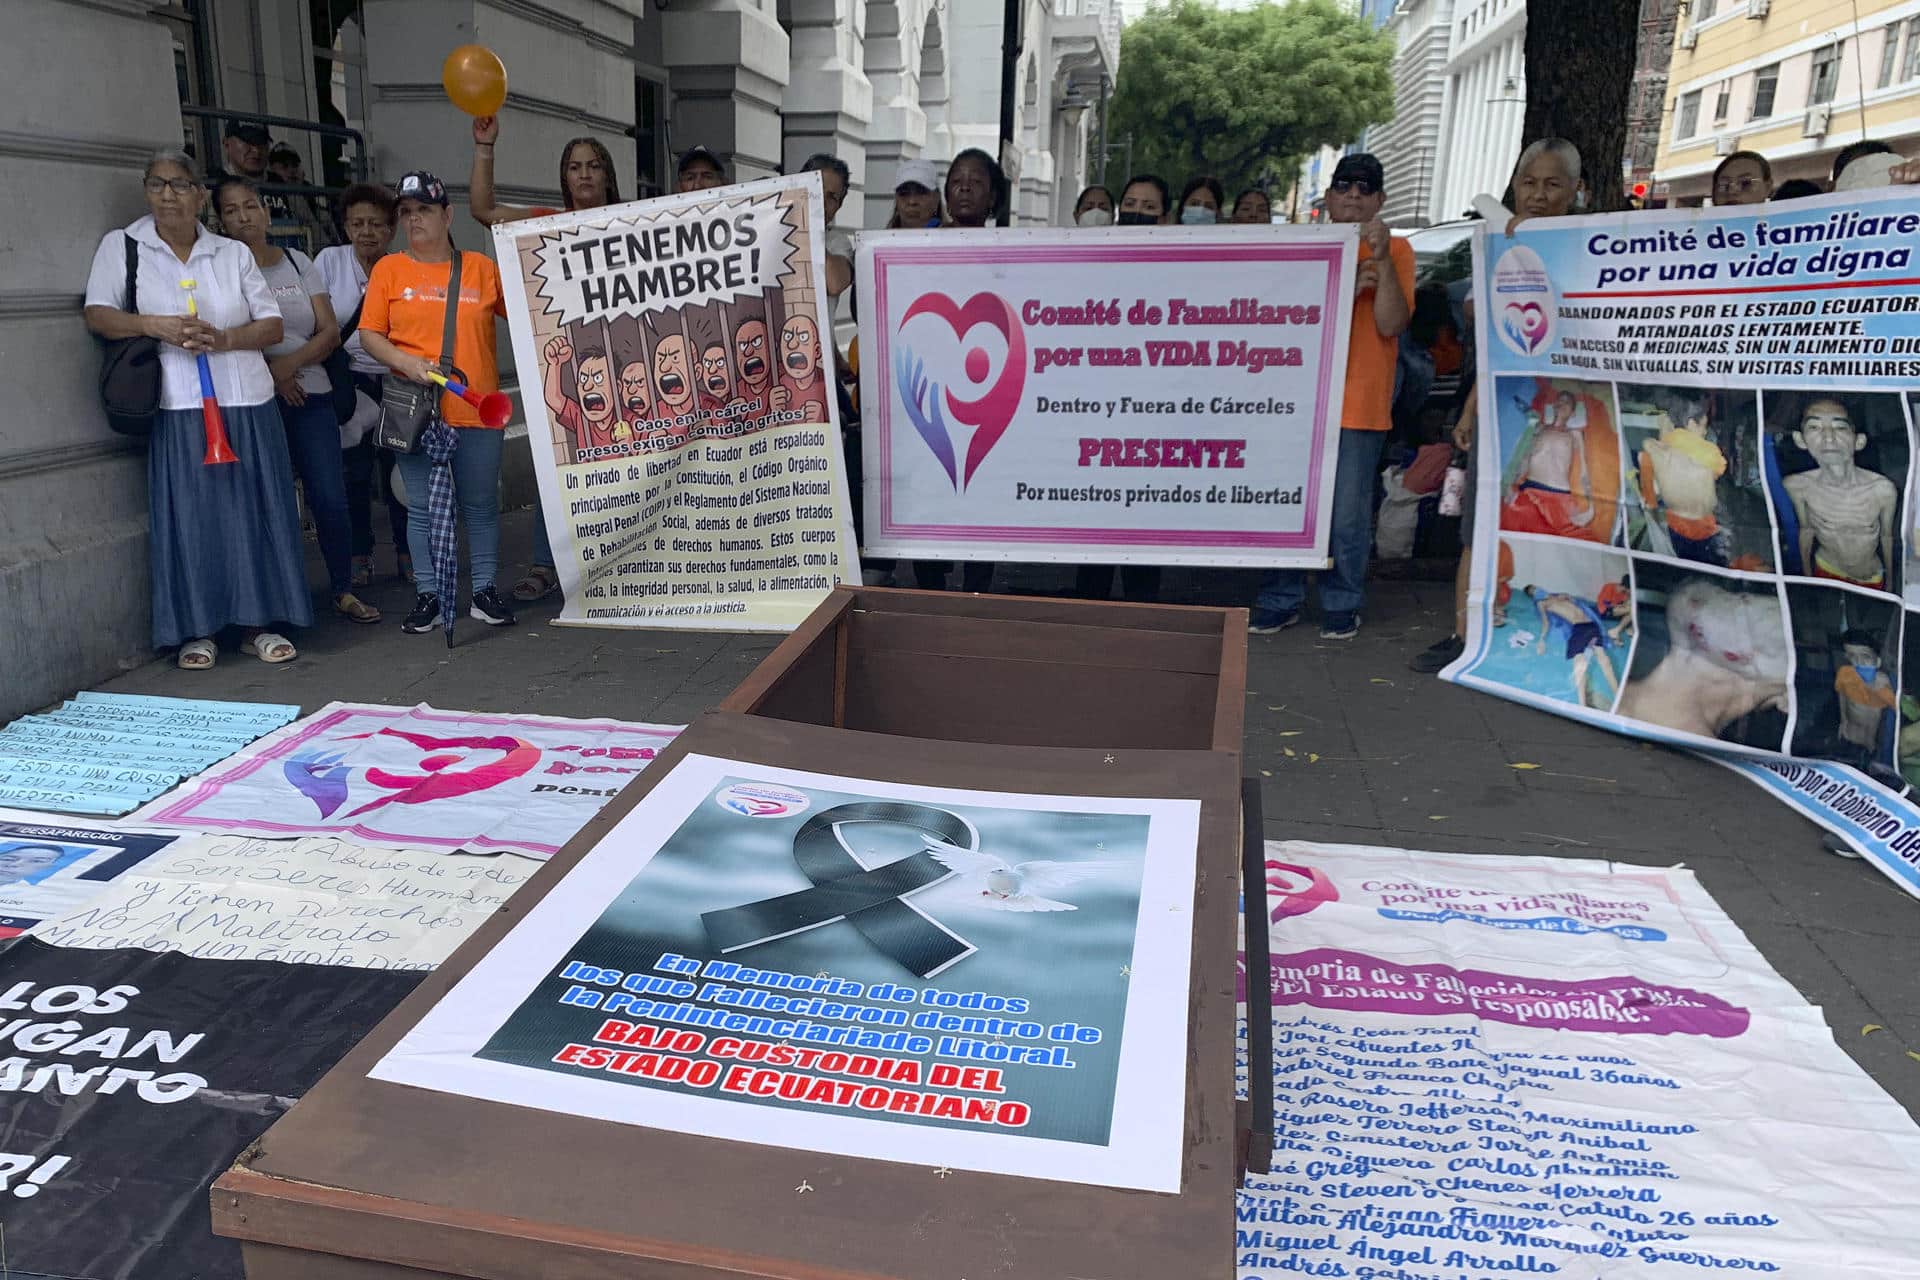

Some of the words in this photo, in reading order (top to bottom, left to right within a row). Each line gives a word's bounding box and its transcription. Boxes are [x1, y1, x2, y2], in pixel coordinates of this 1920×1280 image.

[559, 213, 758, 280] ¡TENEMOS
[1587, 228, 1697, 256] Comité
[1707, 226, 1746, 249] de
[1755, 212, 1920, 246] familiare
[581, 248, 760, 313] HAMBRE!
[1597, 266, 1650, 289] por
[1659, 262, 1717, 281] una
[1729, 252, 1798, 278] vida
[1806, 246, 1911, 278] digna
[1022, 298, 1122, 326] Comité
[1127, 299, 1162, 325] de
[1167, 298, 1321, 326] Familiares
[1558, 305, 1675, 320] ABANDONADOS
[1680, 304, 1715, 319] POR
[1721, 303, 1739, 318] EL
[1744, 300, 1816, 317] ESTADO
[1821, 296, 1920, 315] ECUATOR
[1617, 322, 1734, 339] MATANDALOS
[1738, 320, 1865, 338] LENTAMENTE.
[1033, 347, 1083, 373] por
[1087, 347, 1142, 367] una
[1144, 340, 1211, 367] VIDA
[1216, 340, 1303, 374] Digna
[1562, 336, 1578, 349] SIN
[1579, 338, 1625, 354] ACCESO
[1628, 340, 1639, 354] A
[1644, 339, 1729, 356] MEDICINAS,
[1735, 339, 1764, 354] SIN
[1766, 339, 1791, 354] UN
[1793, 338, 1886, 354] ALIMENTO
[1551, 353, 1569, 365] SIN
[1603, 356, 1622, 371] SIN
[1706, 360, 1733, 374] SIN
[1738, 360, 1804, 375] VISITAS
[1808, 361, 1920, 376] FAMILIARES
[634, 418, 672, 432] Caos
[675, 415, 695, 426] en
[715, 398, 761, 418] cárcel
[1036, 396, 1101, 414] Dentro
[1105, 400, 1116, 418] y
[1119, 397, 1176, 414] Fuera
[1180, 397, 1204, 414] de
[1209, 397, 1295, 414] Cárceles
[577, 445, 629, 461] presos
[633, 434, 685, 450] exigen
[688, 421, 742, 438] comida
[757, 410, 802, 429] gritos
[566, 473, 578, 489] Un
[585, 468, 620, 488] privado
[646, 453, 681, 477] libertad
[706, 446, 742, 462] Ecuador
[749, 438, 767, 456] está
[774, 431, 825, 450] respaldado
[1078, 437, 1247, 469] PRESENTE
[570, 491, 640, 516] principalmente
[676, 470, 733, 487] Constitución,
[752, 461, 783, 480] Código
[788, 456, 828, 473] Orgánico
[1016, 482, 1045, 501] Por
[1049, 484, 1121, 503] nuestros
[1125, 485, 1202, 507] privados
[1206, 485, 1227, 503] de
[1231, 485, 1303, 505] libertad
[576, 518, 612, 538] Integral
[615, 512, 640, 531] Penal
[641, 499, 665, 522] (COIP)
[684, 492, 738, 509] Reglamento
[755, 485, 790, 503] Sistema
[792, 480, 830, 496] Nacional
[662, 514, 690, 531] Social,
[695, 517, 730, 531] además
[753, 508, 791, 528] diversos
[796, 504, 833, 520] tratados
[673, 537, 713, 552] derechos
[719, 538, 764, 552] humanos.
[771, 532, 794, 547] Estos
[801, 530, 836, 545] cuerpos
[617, 559, 665, 577] garantizan
[686, 560, 727, 573] derechos
[730, 554, 800, 572] fundamentales,
[803, 553, 827, 566] como
[584, 586, 607, 598] vida,
[622, 581, 668, 598] integridad
[672, 581, 713, 596] personal,
[728, 578, 755, 593] salud,
[770, 574, 830, 591] alimentación,
[19, 825, 122, 842] DESAPARECIDO
[0, 982, 141, 1014] LOS
[655, 953, 702, 976] En
[702, 960, 863, 996] Memoria
[869, 983, 916, 1003] de
[922, 988, 1029, 1014] todos
[559, 961, 623, 985] los
[622, 972, 697, 997] que
[697, 983, 908, 1025] Fallecieron
[914, 1011, 1043, 1039] dentro
[1048, 1022, 1102, 1044] de
[559, 985, 603, 1008] la
[937, 1036, 1076, 1067] Litoral.
[593, 1019, 706, 1053] BAJO
[706, 1036, 921, 1084] CUSTODIA
[926, 1063, 1007, 1093] DEL
[552, 1043, 722, 1088] ESTADO
[720, 1065, 1031, 1126] ECUATORIANO
[1522, 1110, 1700, 1136] Maximiliano
[1448, 1157, 1538, 1177] Carlos
[1321, 1182, 1416, 1199] Steven
[1659, 1211, 1695, 1226] 26
[1704, 1212, 1779, 1227] años
[1237, 1207, 1331, 1226] Milton
[1638, 1246, 1780, 1272] Guerrero
[1237, 1230, 1341, 1251] Miguel
[1347, 1235, 1437, 1266] Ángel
[1237, 1253, 1349, 1277] Andrés
